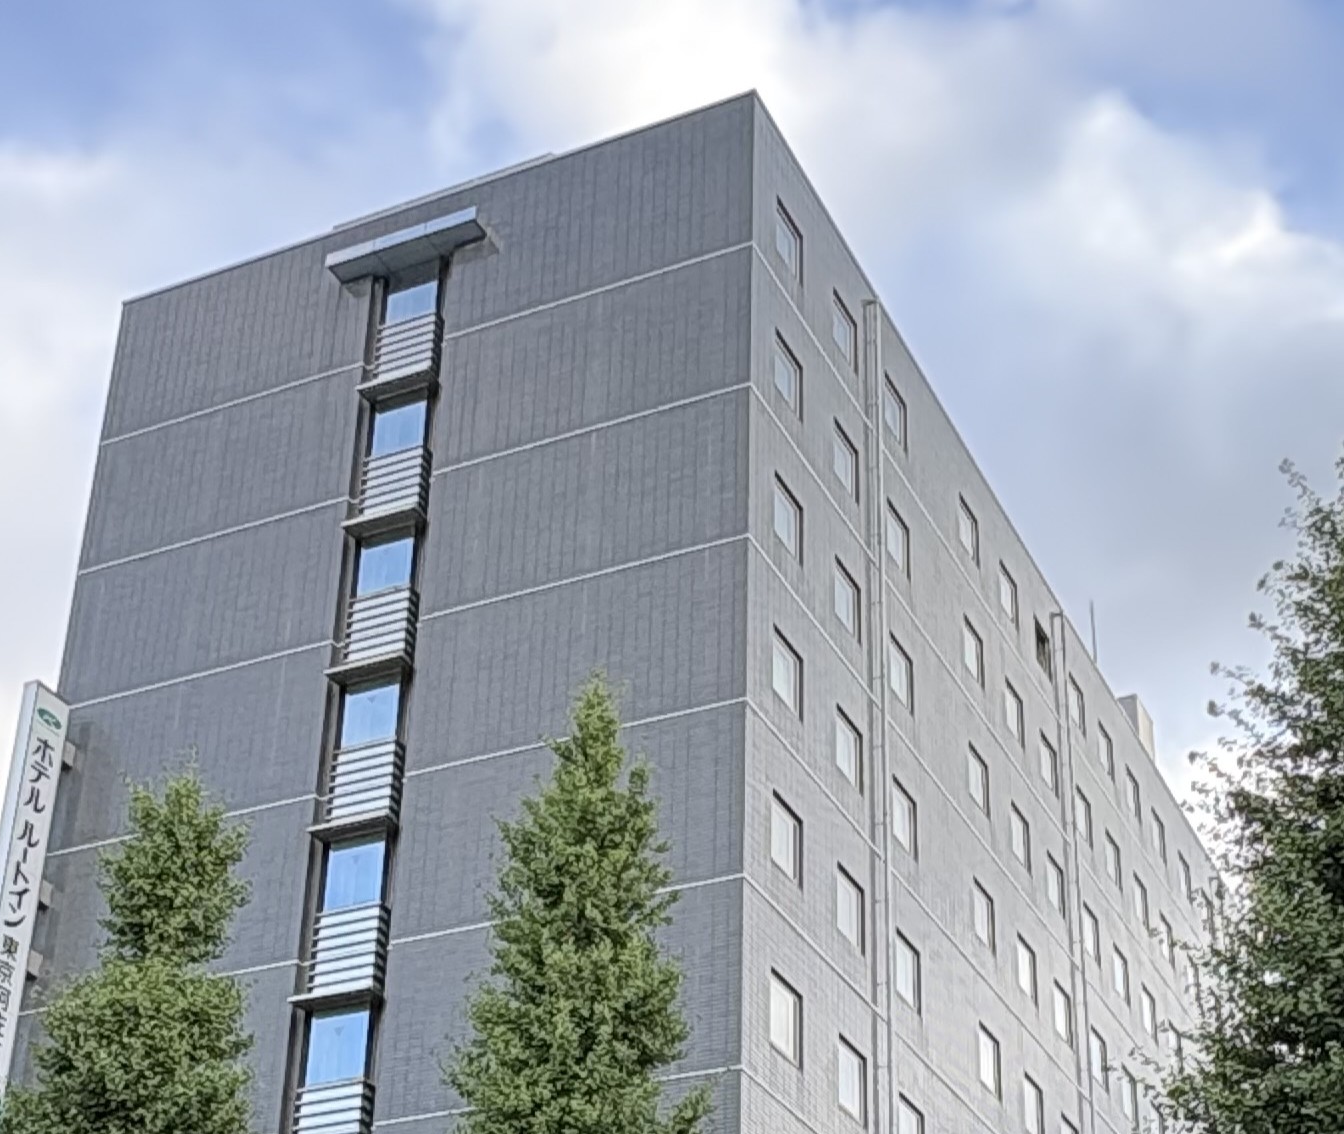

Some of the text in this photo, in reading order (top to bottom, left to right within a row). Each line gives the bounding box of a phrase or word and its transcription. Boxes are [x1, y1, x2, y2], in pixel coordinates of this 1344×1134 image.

[23, 737, 55, 814] ホテル
[3, 819, 40, 928] ルートイン
